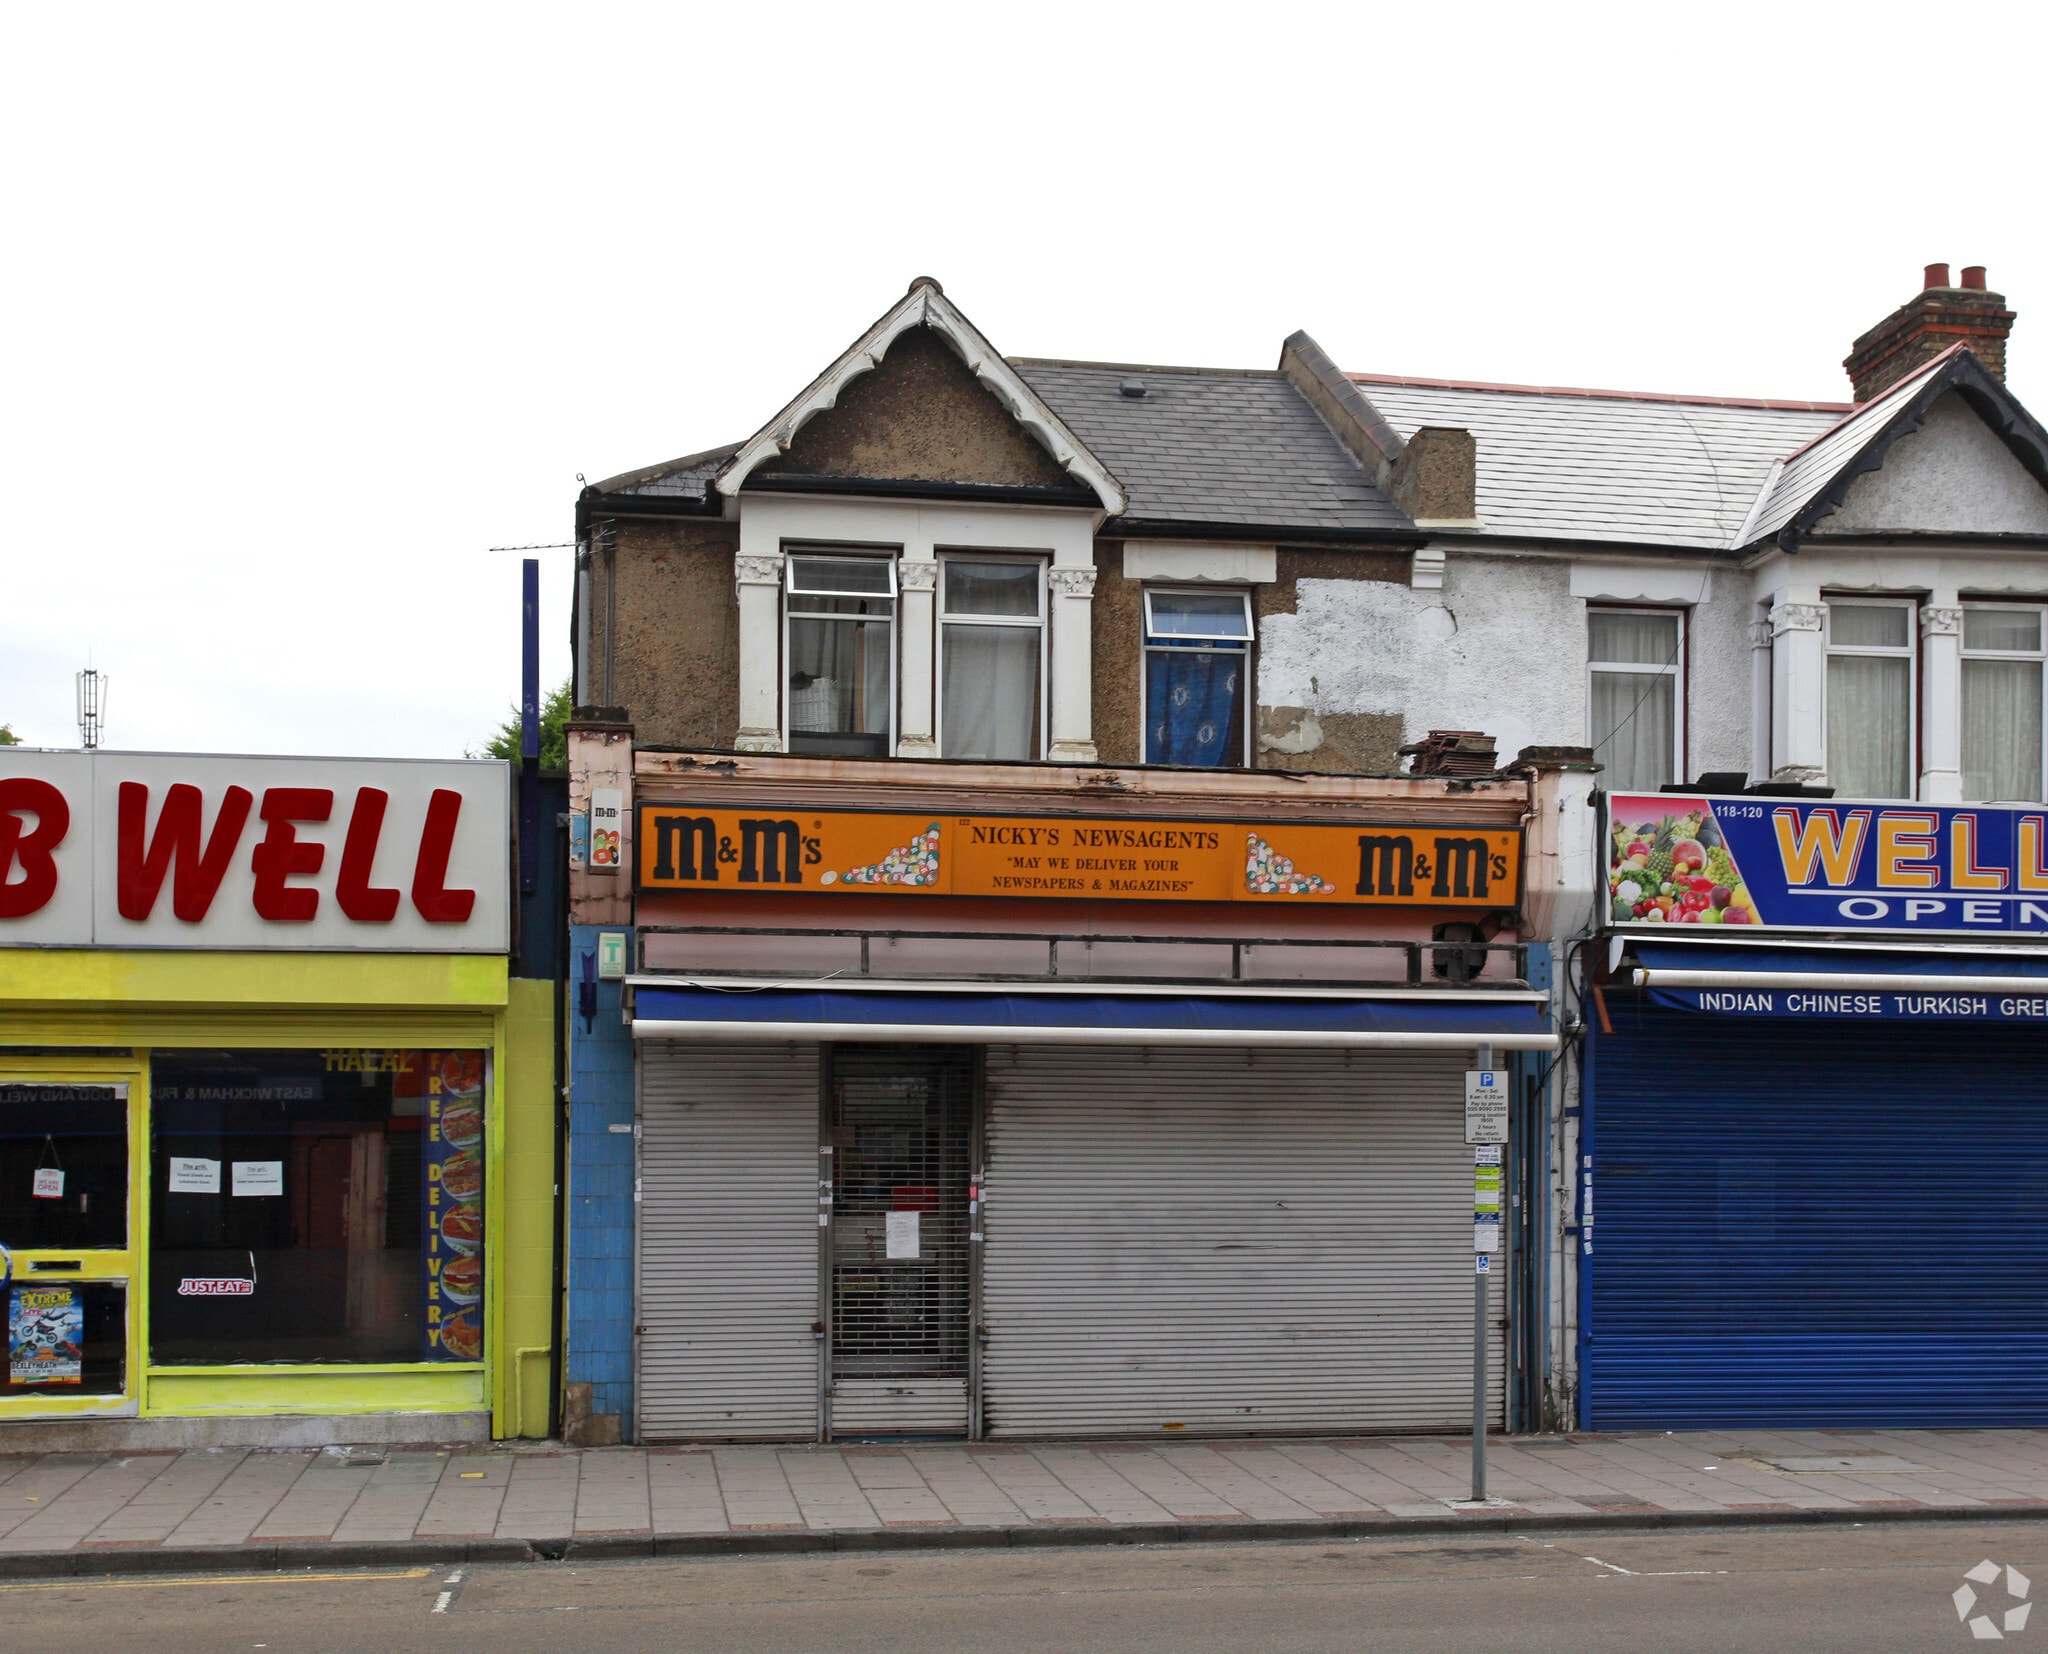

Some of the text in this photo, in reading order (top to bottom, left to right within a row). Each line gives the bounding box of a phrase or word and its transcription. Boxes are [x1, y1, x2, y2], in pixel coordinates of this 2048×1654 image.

[1715, 805, 1763, 819] 118-120
[959, 818, 971, 826] 122
[971, 826, 1219, 849] NICKY'S NEWSAGENTS
[117, 781, 477, 923] WELL
[1048, 857, 1070, 869] WE
[1075, 858, 1137, 871] DELIVER
[1143, 859, 1179, 872] YOUR
[992, 876, 1085, 889] NEWSPAPERS
[1092, 878, 1103, 890] &
[1700, 993, 2048, 1016] INDIAN CHINESE TURKISH GRE
[326, 1048, 414, 1072] HALAL
[429, 1052, 442, 1142] FREE
[427, 1163, 442, 1347] DELIVERY
[217, 1281, 242, 1292] EAT
[20, 1291, 73, 1309] EXTREME
[11, 1361, 57, 1370] BEXLEYHEATH
